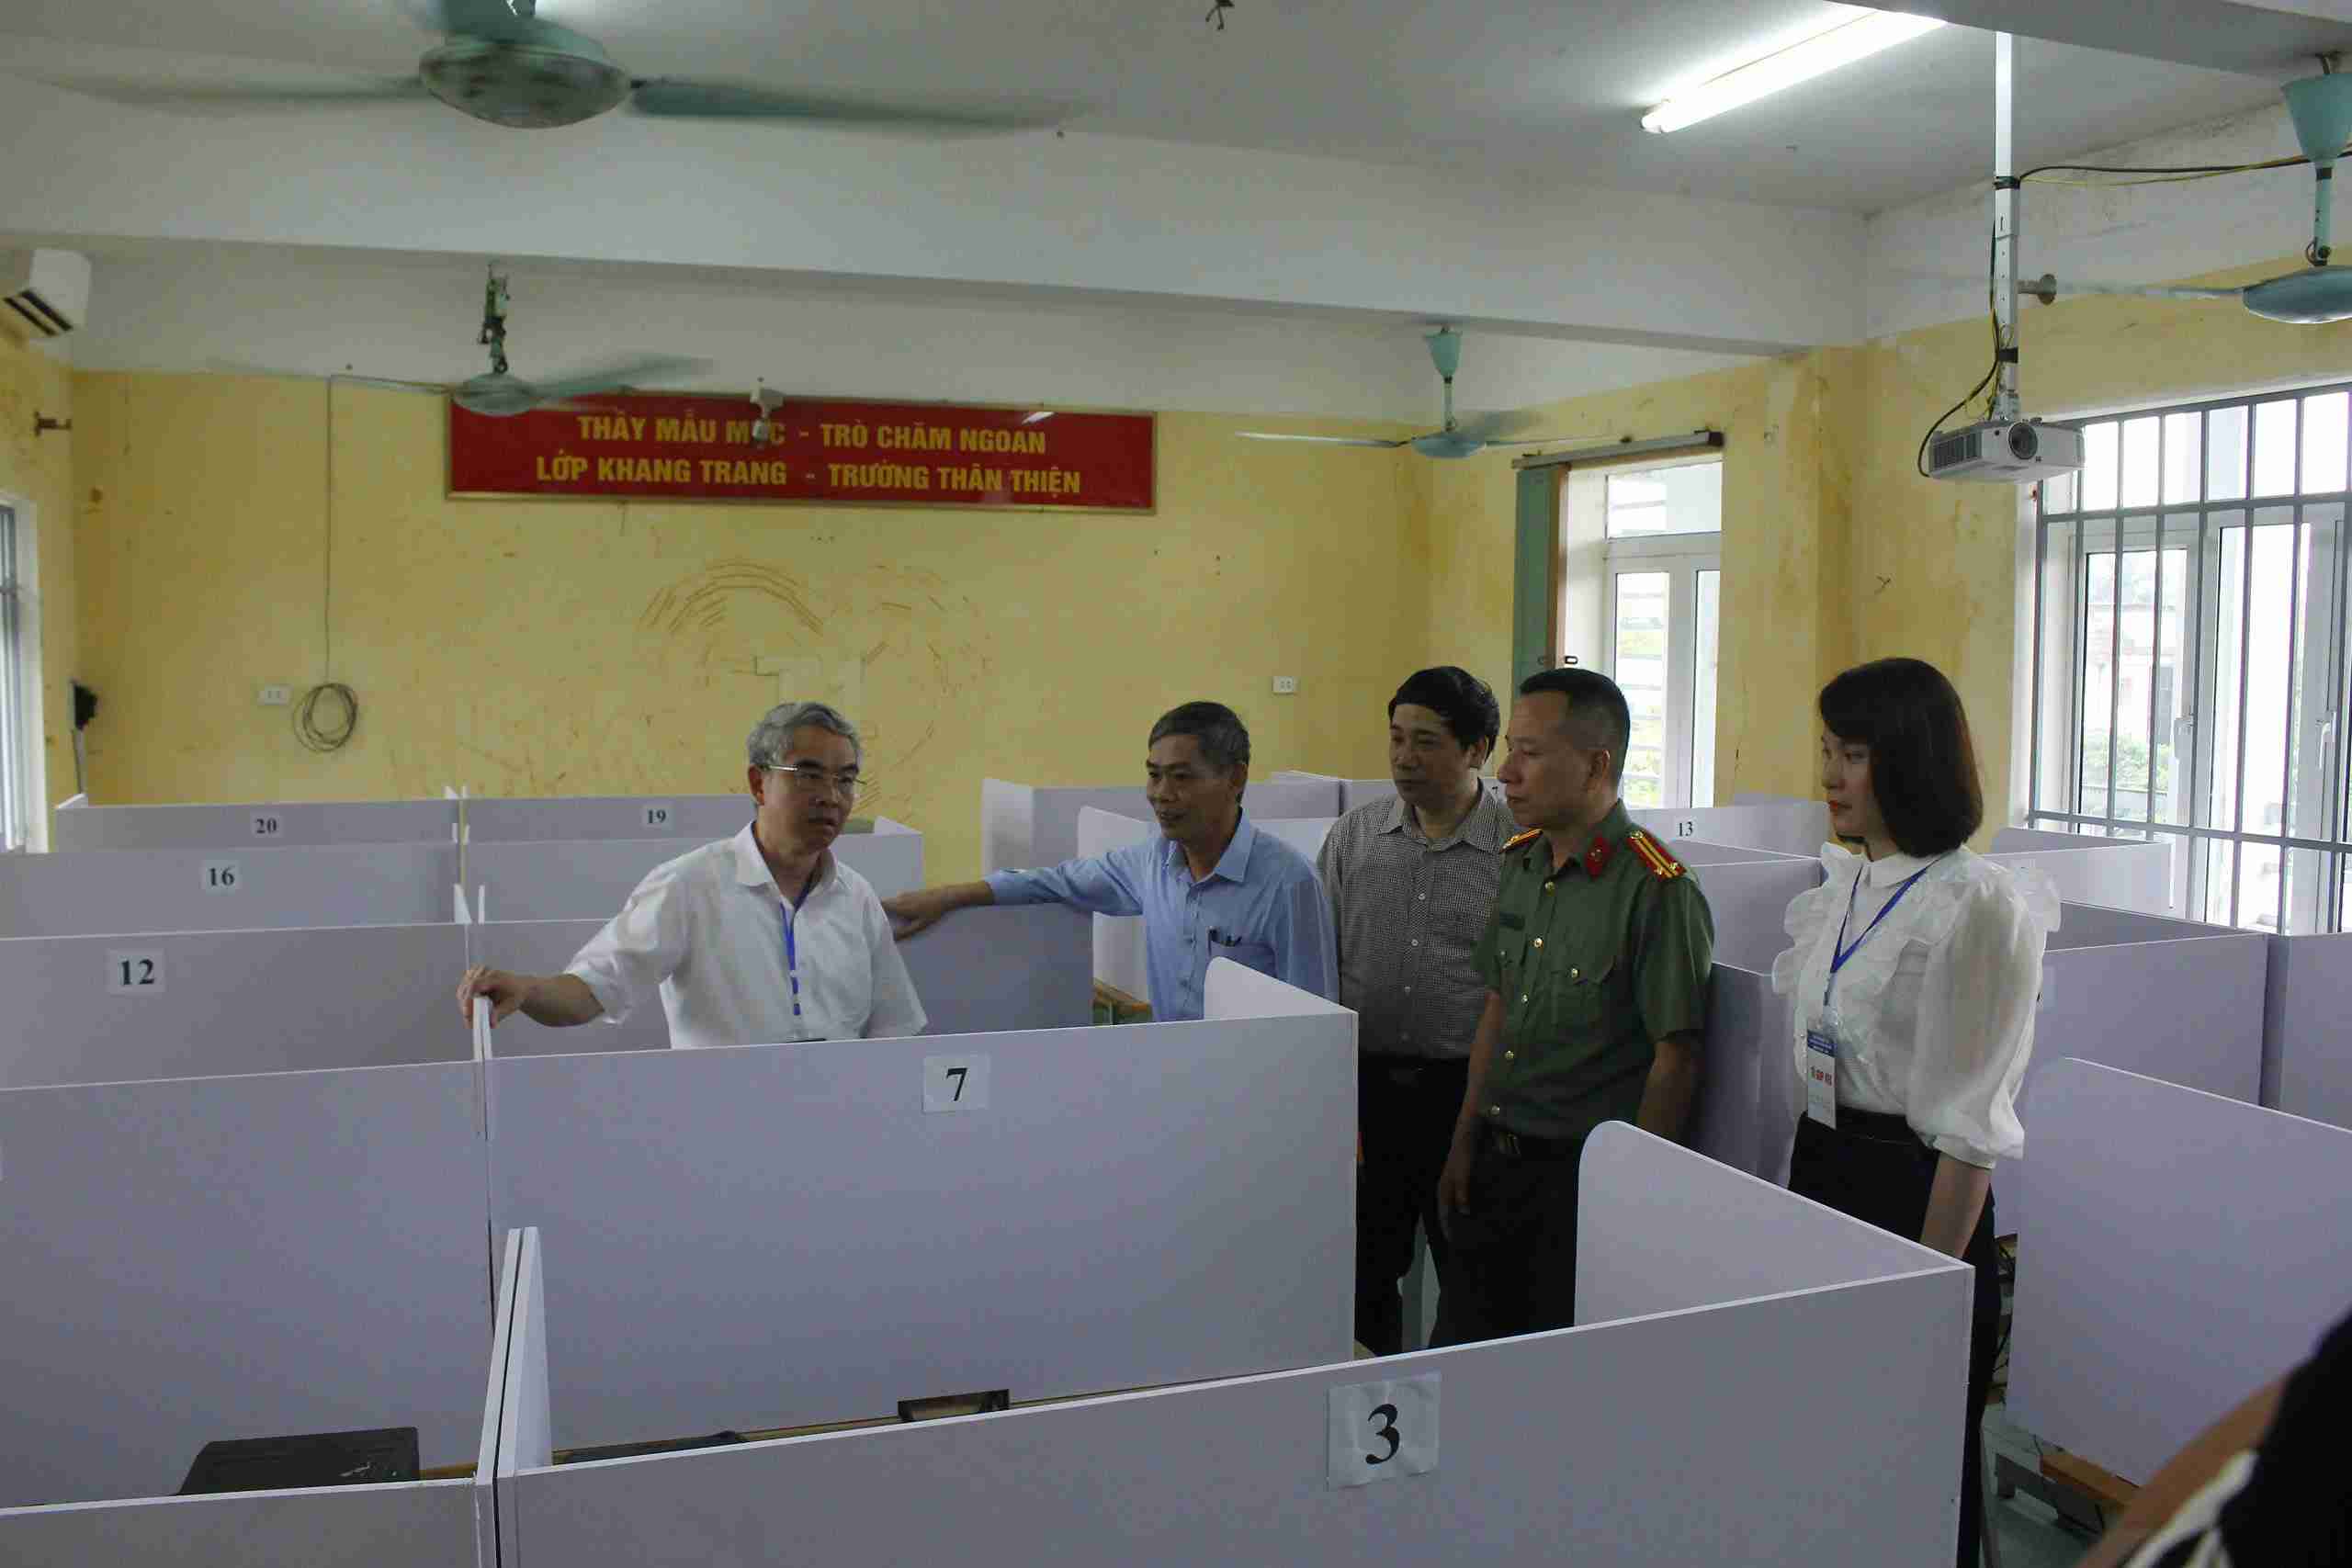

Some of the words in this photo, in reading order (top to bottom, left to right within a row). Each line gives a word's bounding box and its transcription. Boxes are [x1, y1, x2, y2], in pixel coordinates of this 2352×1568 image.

[726, 419, 786, 446] MC
[820, 419, 868, 448] TRÒ
[876, 421, 952, 450] CHĂM
[960, 427, 1046, 454] NGOAN
[537, 448, 588, 481] LỚP
[598, 457, 691, 483] KHANG
[699, 459, 787, 485] TRANG
[829, 458, 929, 490] TRƯỜNG
[938, 463, 1001, 491] THÂN
[1011, 466, 1081, 498] THIỆN
[255, 818, 278, 834] 20
[646, 809, 667, 825] 19
[1679, 821, 1693, 837] 13
[209, 867, 235, 887] 16
[119, 958, 155, 986] 12
[945, 1067, 968, 1102] 7
[1365, 1403, 1400, 1465] 3
